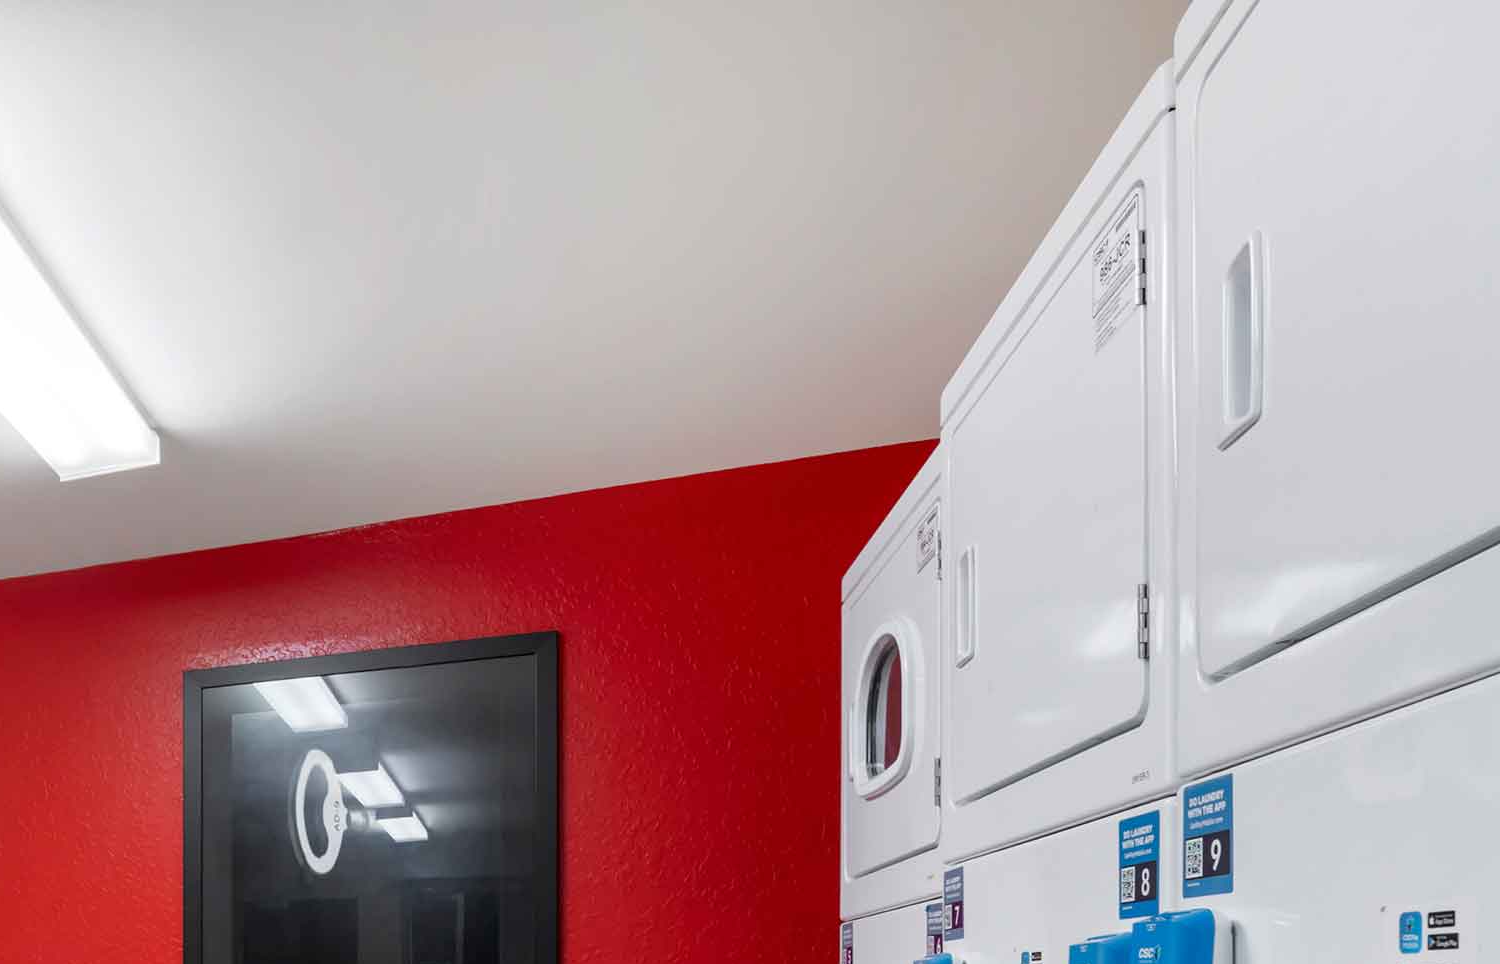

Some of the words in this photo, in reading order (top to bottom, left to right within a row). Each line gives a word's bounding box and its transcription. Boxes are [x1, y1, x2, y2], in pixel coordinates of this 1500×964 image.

[1198, 789, 1224, 805] LAUNDRY
[1188, 808, 1202, 819] WITH
[1203, 804, 1213, 814] THE
[1214, 800, 1226, 812] APP
[1210, 838, 1222, 872] 9
[1141, 868, 1150, 896] 8
[954, 905, 960, 927] 7
[1138, 947, 1156, 959] CSC
